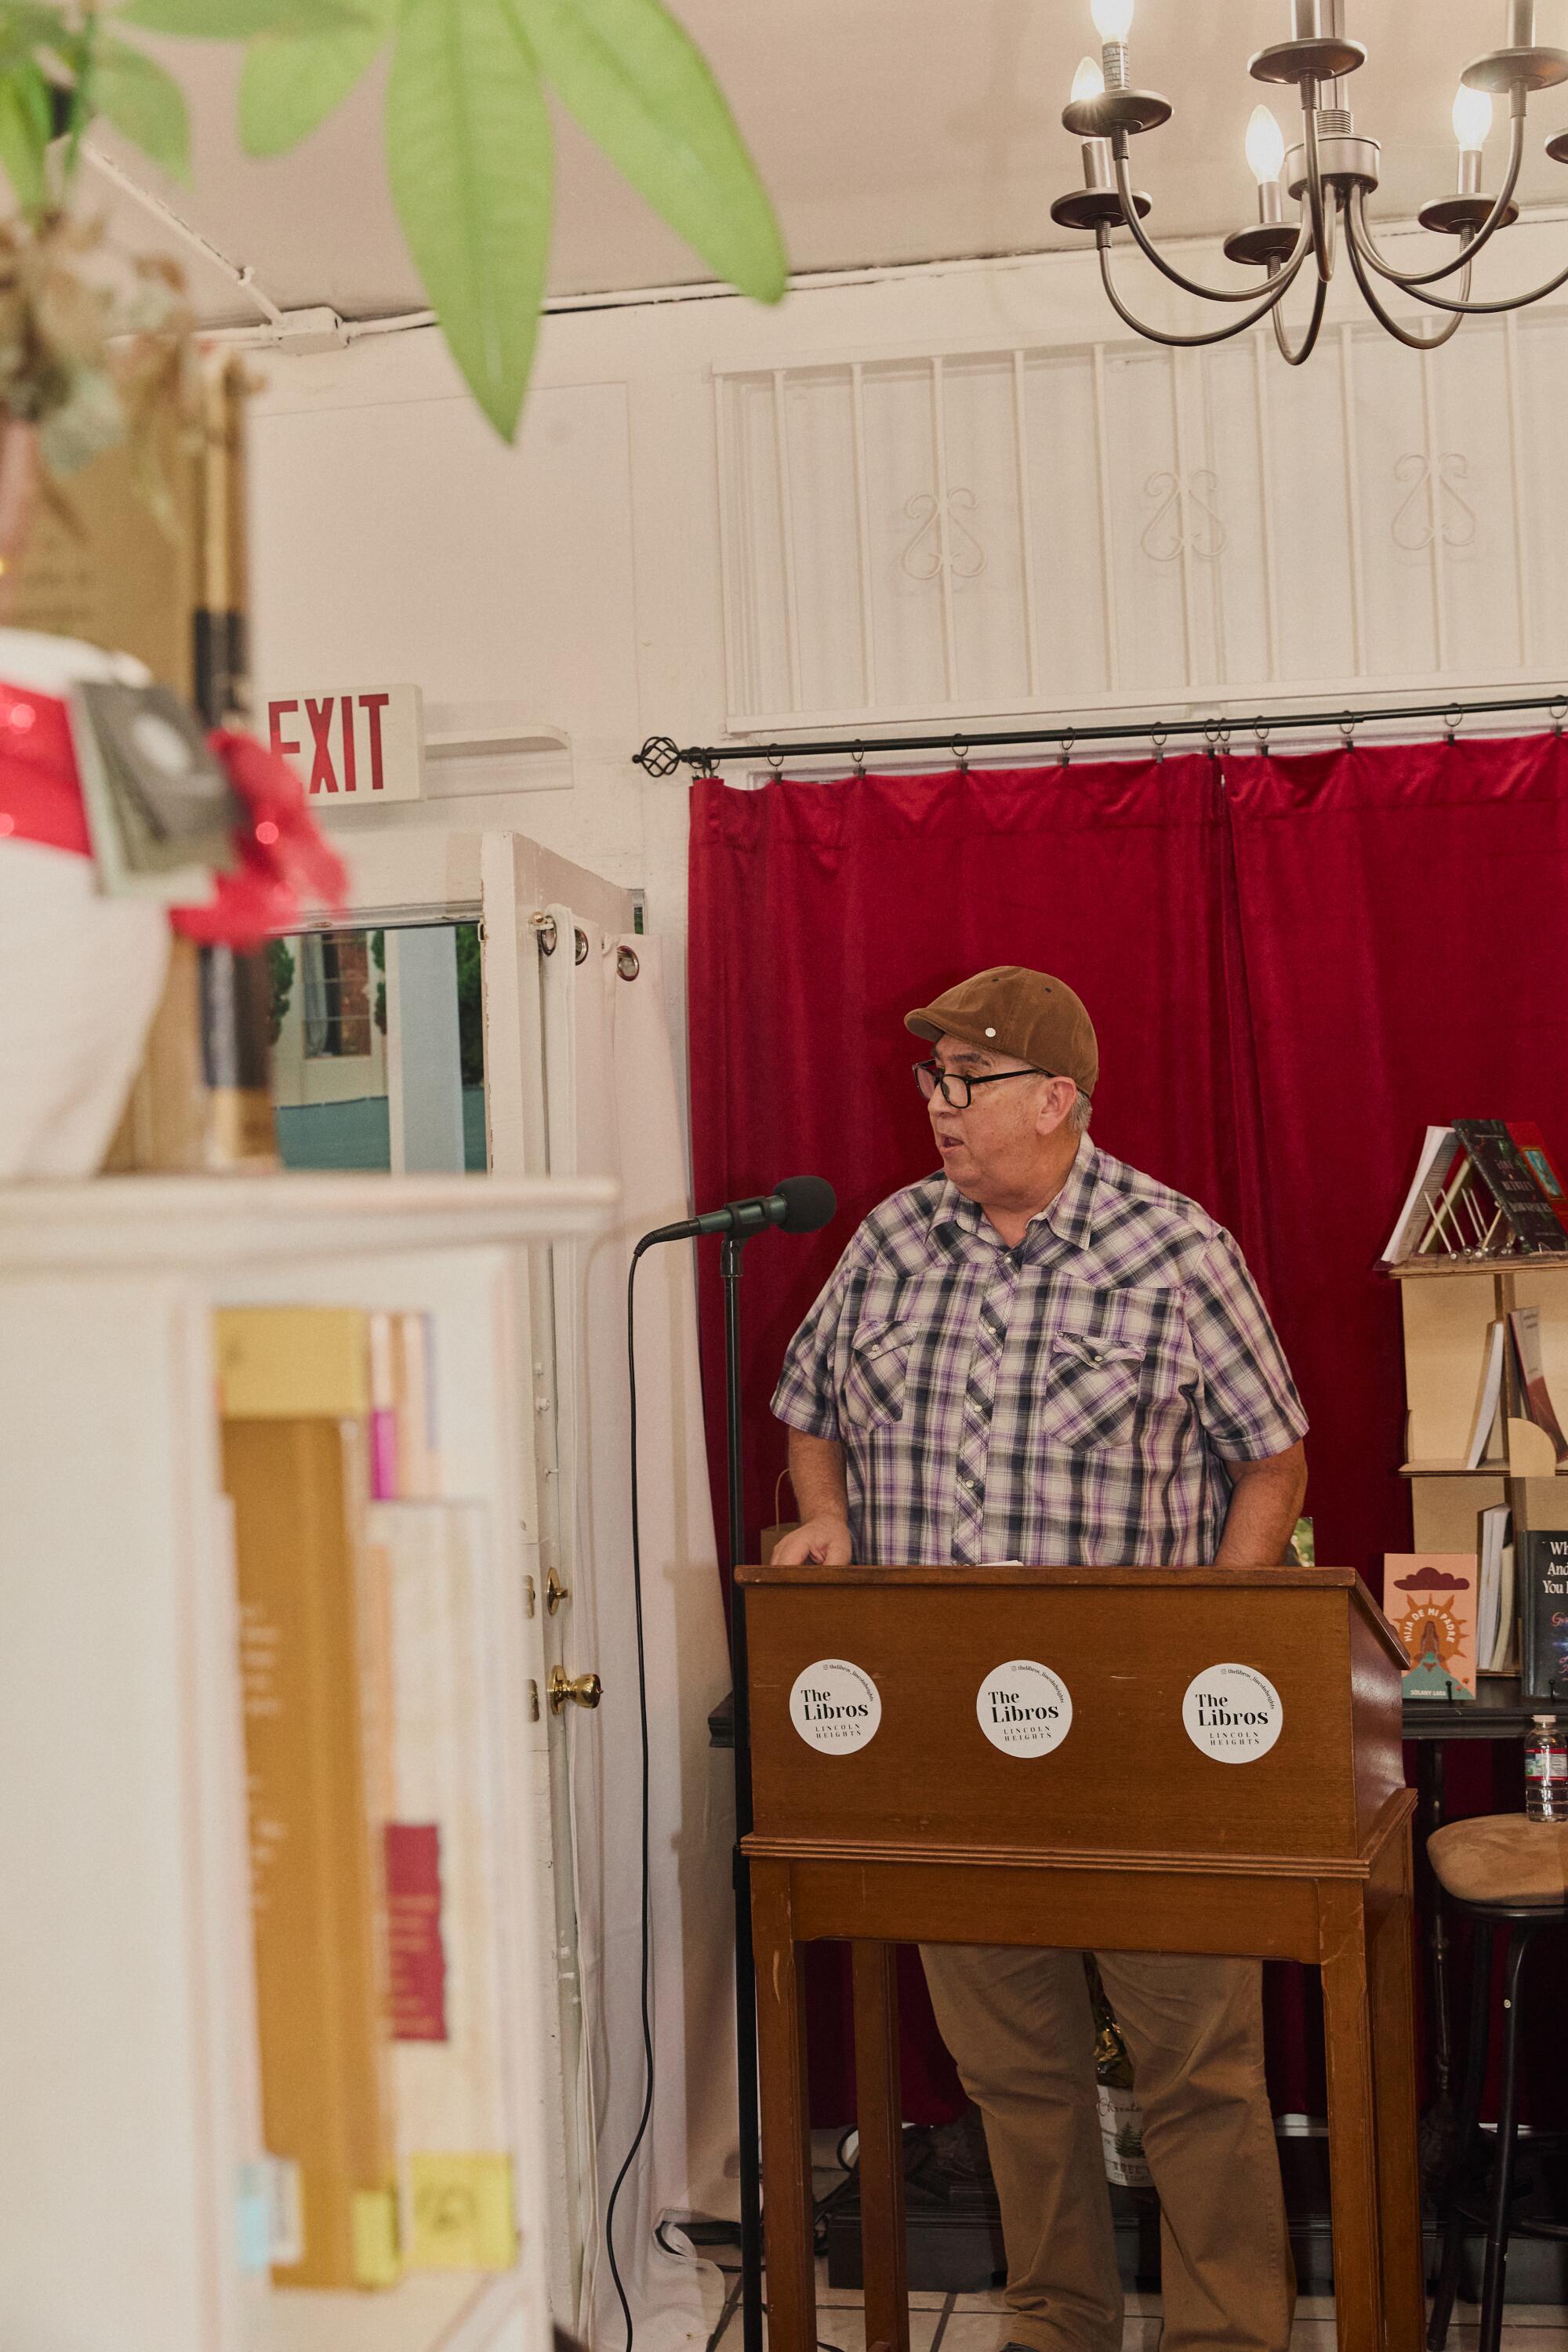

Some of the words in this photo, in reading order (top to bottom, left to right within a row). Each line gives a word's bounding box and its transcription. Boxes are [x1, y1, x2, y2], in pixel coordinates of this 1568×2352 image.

[268, 693, 389, 793] EXIT
[1542, 1580, 1564, 1594] You
[1403, 1621, 1414, 1642] HIJA
[1411, 1609, 1425, 1621] DE
[1428, 1608, 1439, 1617] MI
[1439, 1613, 1456, 1643] PADRE
[800, 1690, 831, 1703] The
[988, 1691, 1020, 1704] The
[1195, 1693, 1229, 1708] The
[804, 1704, 869, 1721] Libros
[991, 1705, 1059, 1723] Libros
[1198, 1709, 1269, 1726] Libros
[816, 1730, 861, 1739] HEIGHTS
[1004, 1726, 1051, 1735] LINCOLN
[1004, 1733, 1052, 1742] HEIGHTS
